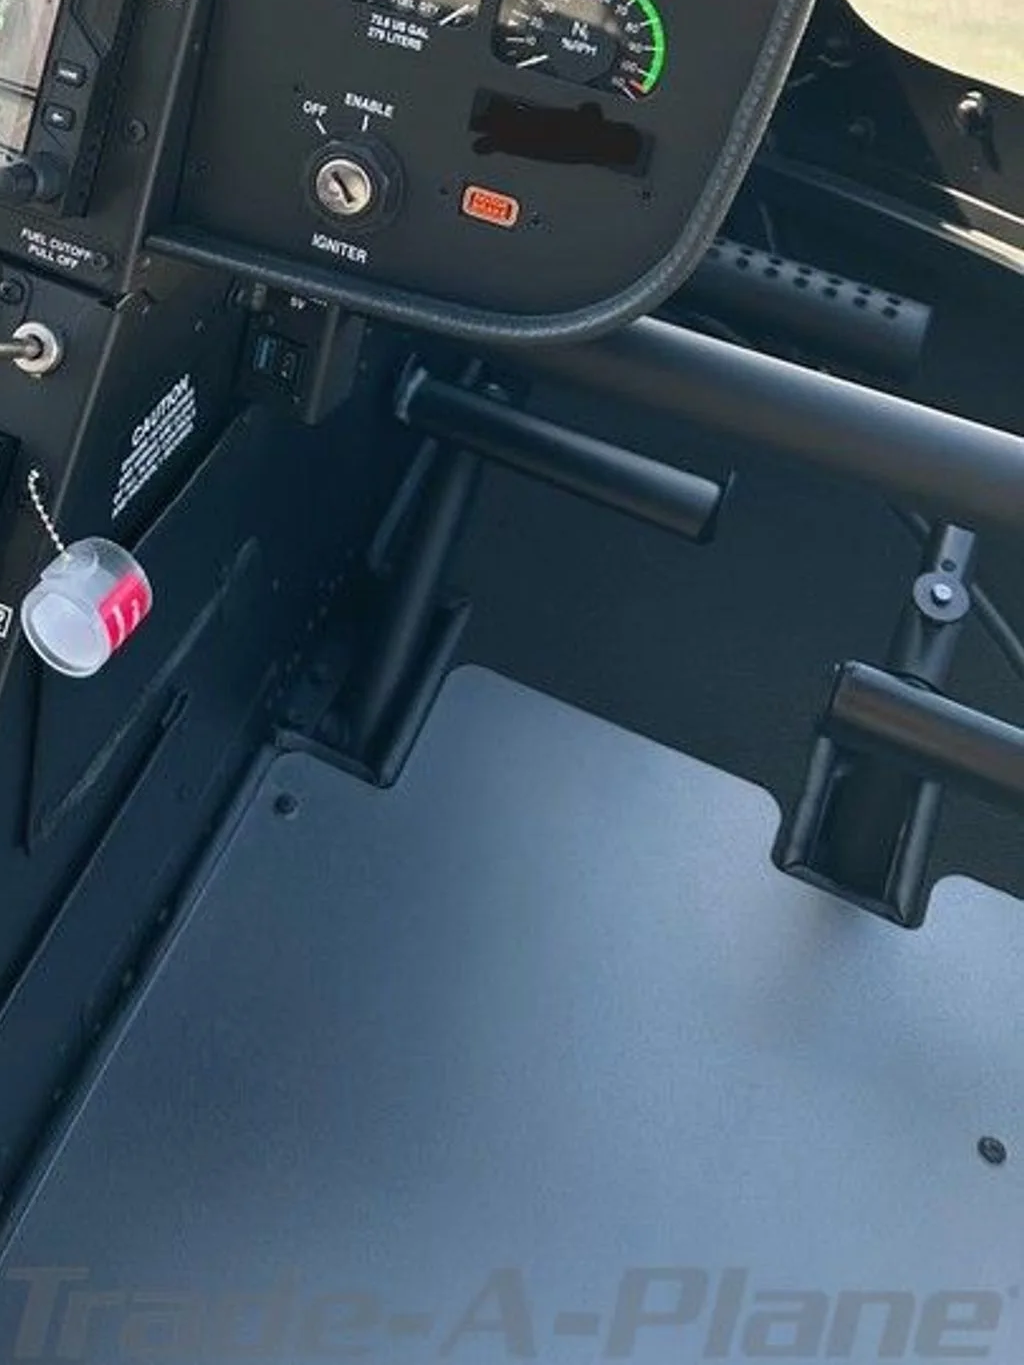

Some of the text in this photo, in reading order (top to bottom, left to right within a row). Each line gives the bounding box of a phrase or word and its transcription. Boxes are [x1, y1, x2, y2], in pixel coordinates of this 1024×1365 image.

[385, 31, 424, 52] LITERS
[302, 100, 328, 118] OFF
[344, 92, 395, 119] ENABLE
[20, 227, 92, 262] FUEL CUTOFF
[28, 243, 80, 270] PULL OFF
[311, 233, 368, 265] IGNITER
[131, 373, 190, 447] CAUTION
